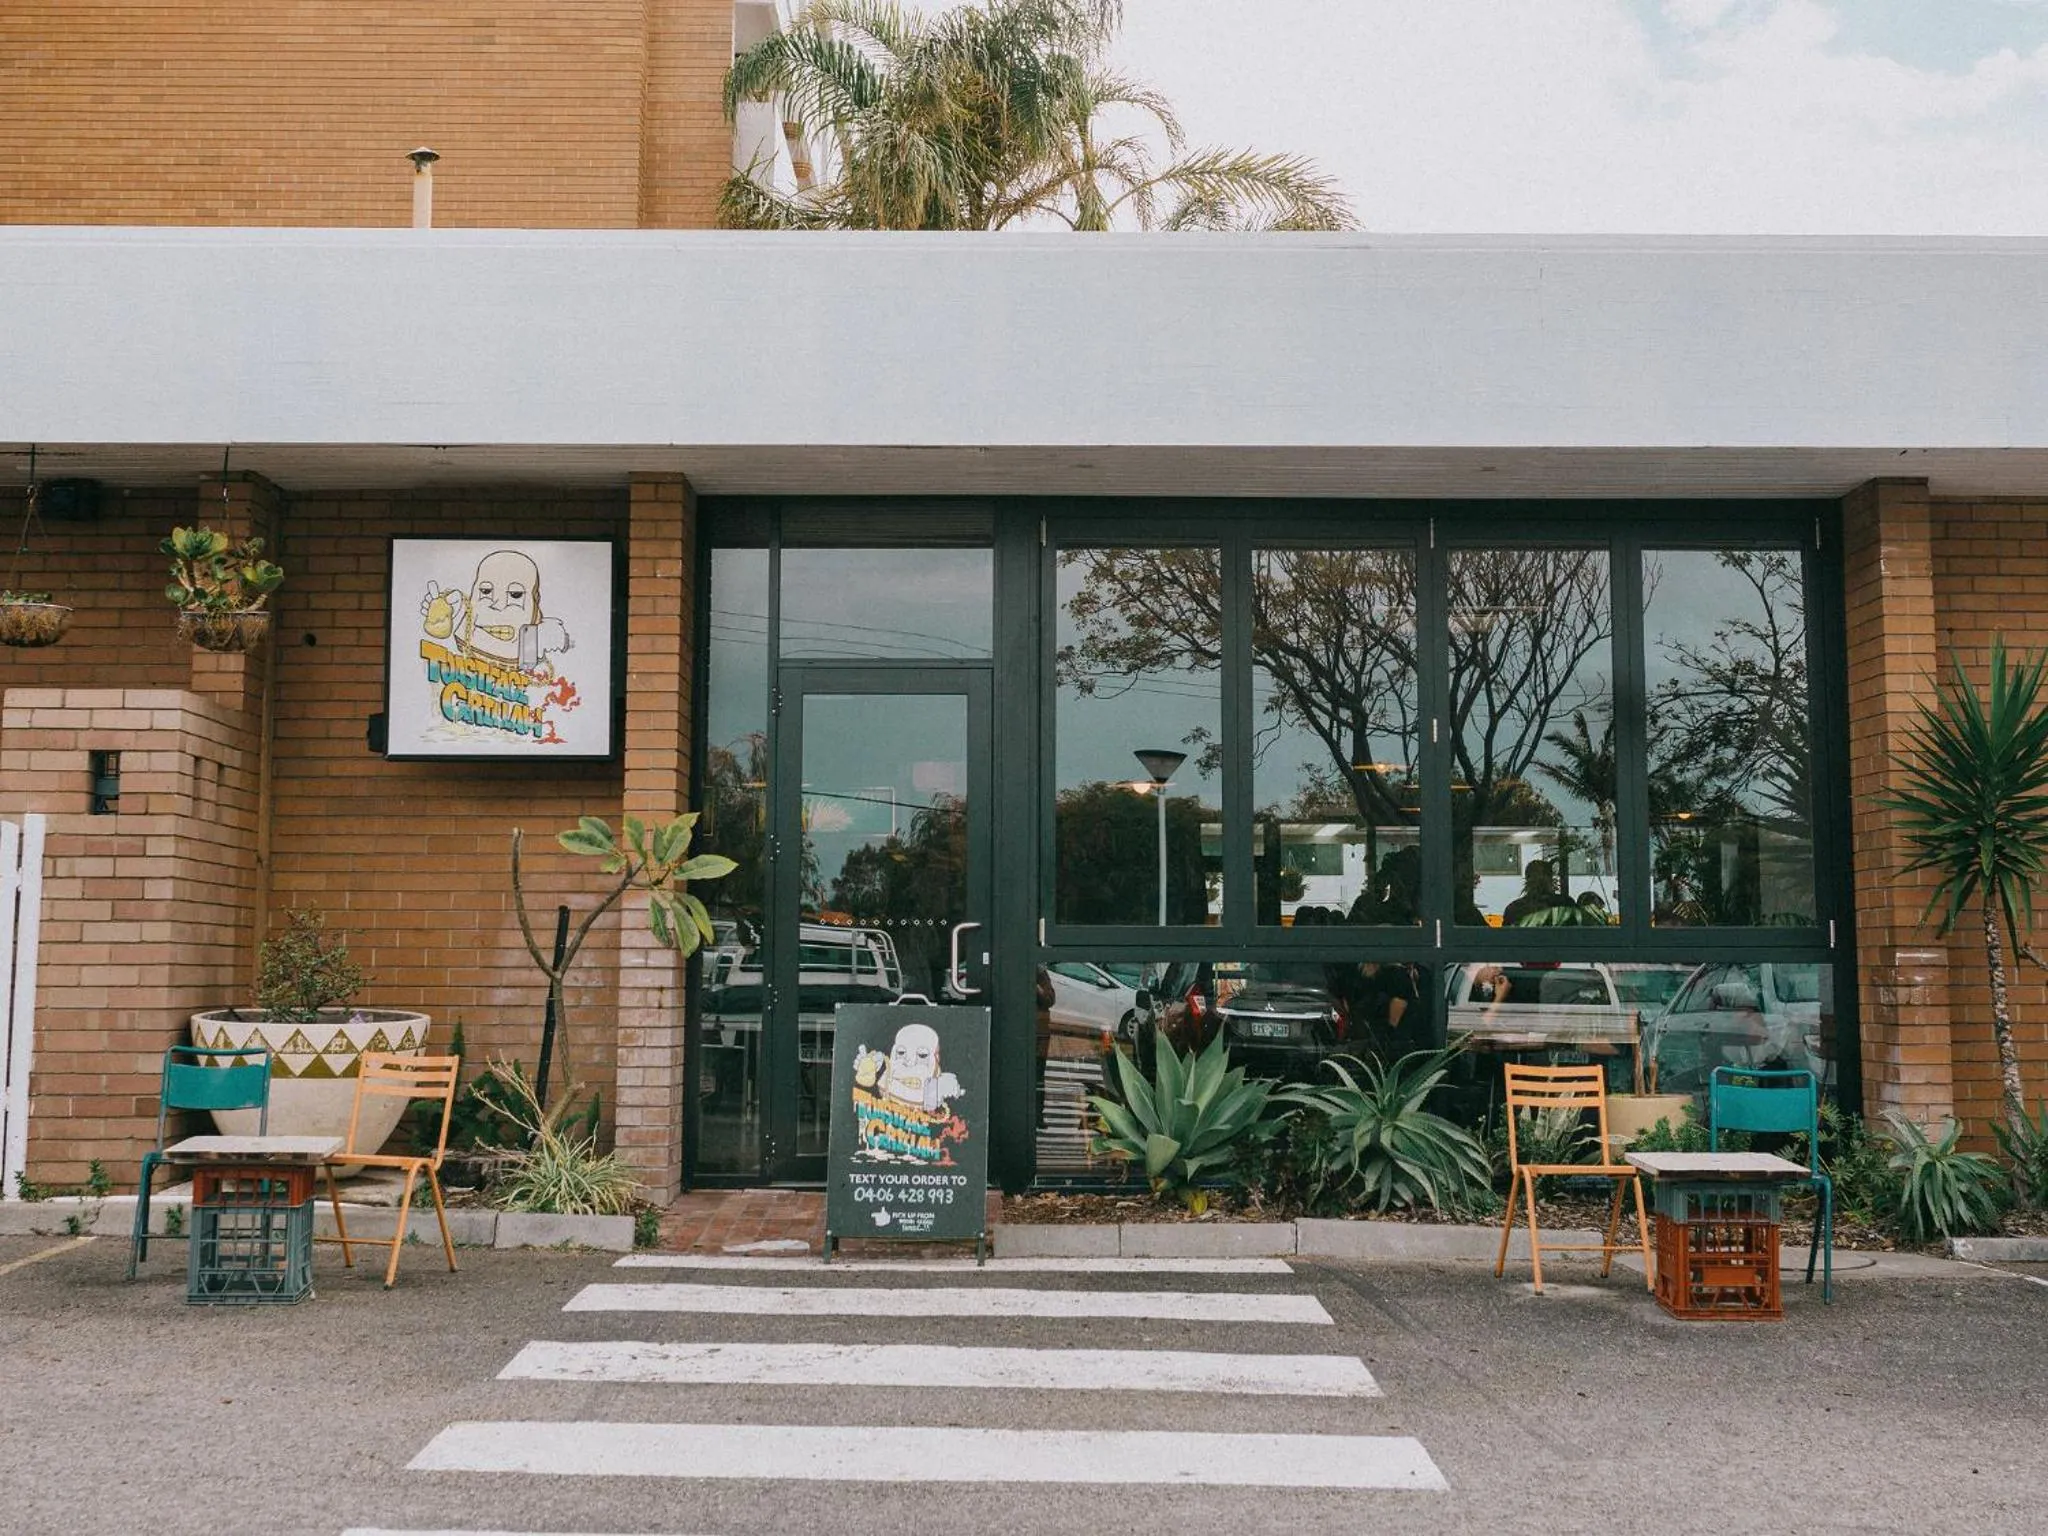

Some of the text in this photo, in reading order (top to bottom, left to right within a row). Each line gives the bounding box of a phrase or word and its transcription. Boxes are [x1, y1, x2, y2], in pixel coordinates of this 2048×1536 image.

[849, 1174, 967, 1186] TEXT YOUR ORDER TO
[854, 1187, 954, 1204] 0406 428 993
